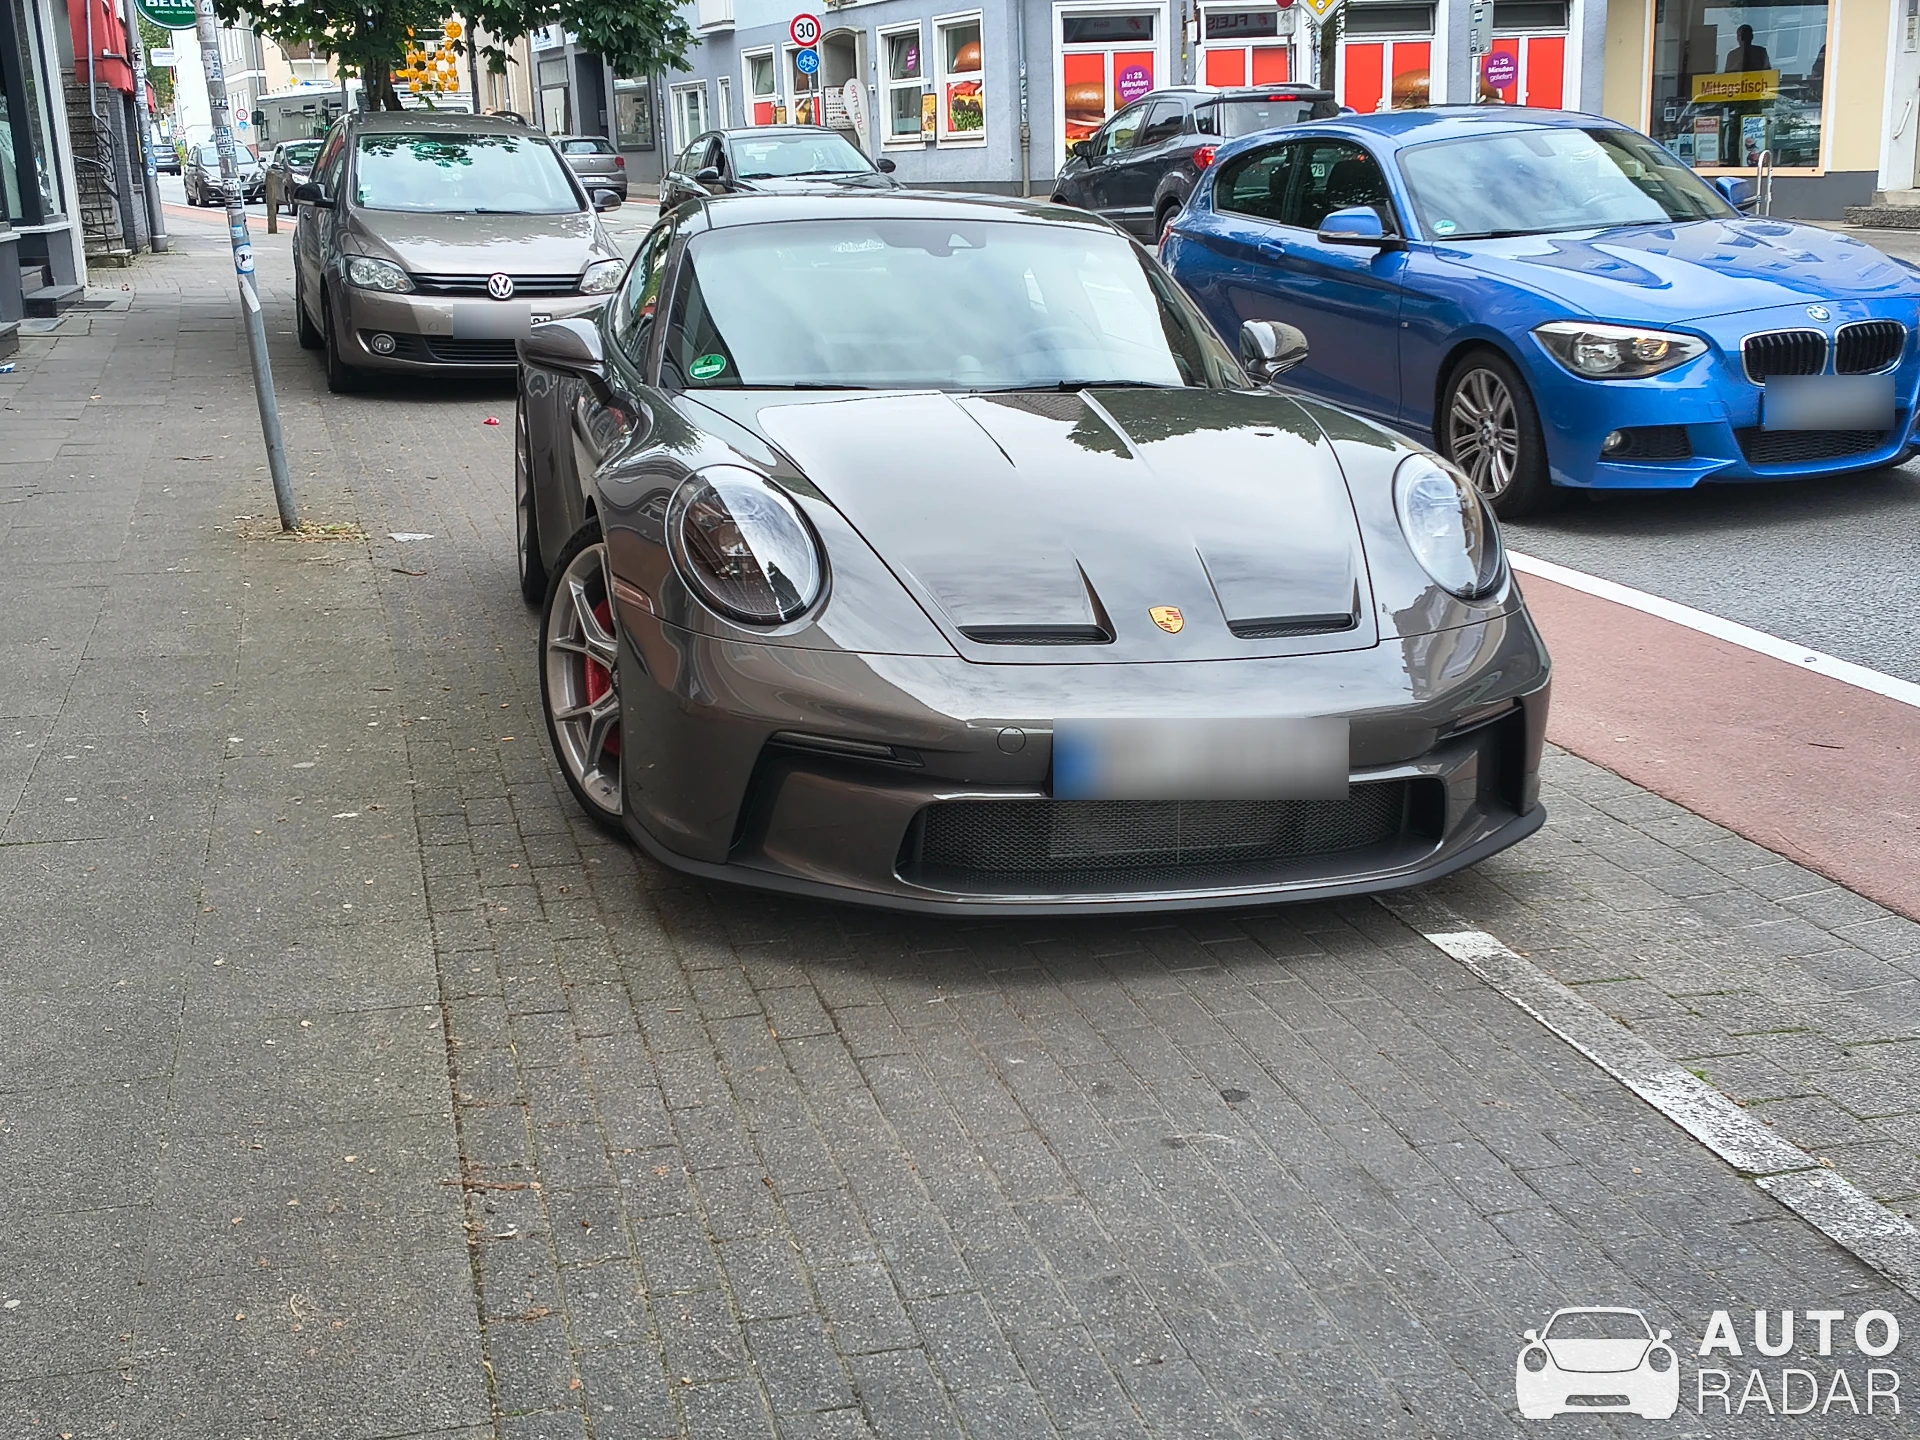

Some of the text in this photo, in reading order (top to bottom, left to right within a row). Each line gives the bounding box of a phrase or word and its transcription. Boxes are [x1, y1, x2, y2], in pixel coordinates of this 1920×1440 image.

[796, 22, 815, 38] 30
[1493, 57, 1509, 66] In 25
[1133, 71, 1143, 79] 25
[1487, 66, 1514, 74] Minuten
[1489, 73, 1513, 82] geliefert
[1121, 79, 1149, 88] Minuten
[1701, 78, 1768, 98] Mittagstisch
[1122, 87, 1147, 97] geliefert
[1312, 164, 1324, 175] 78
[489, 274, 514, 299] VW
[703, 355, 712, 366] 4
